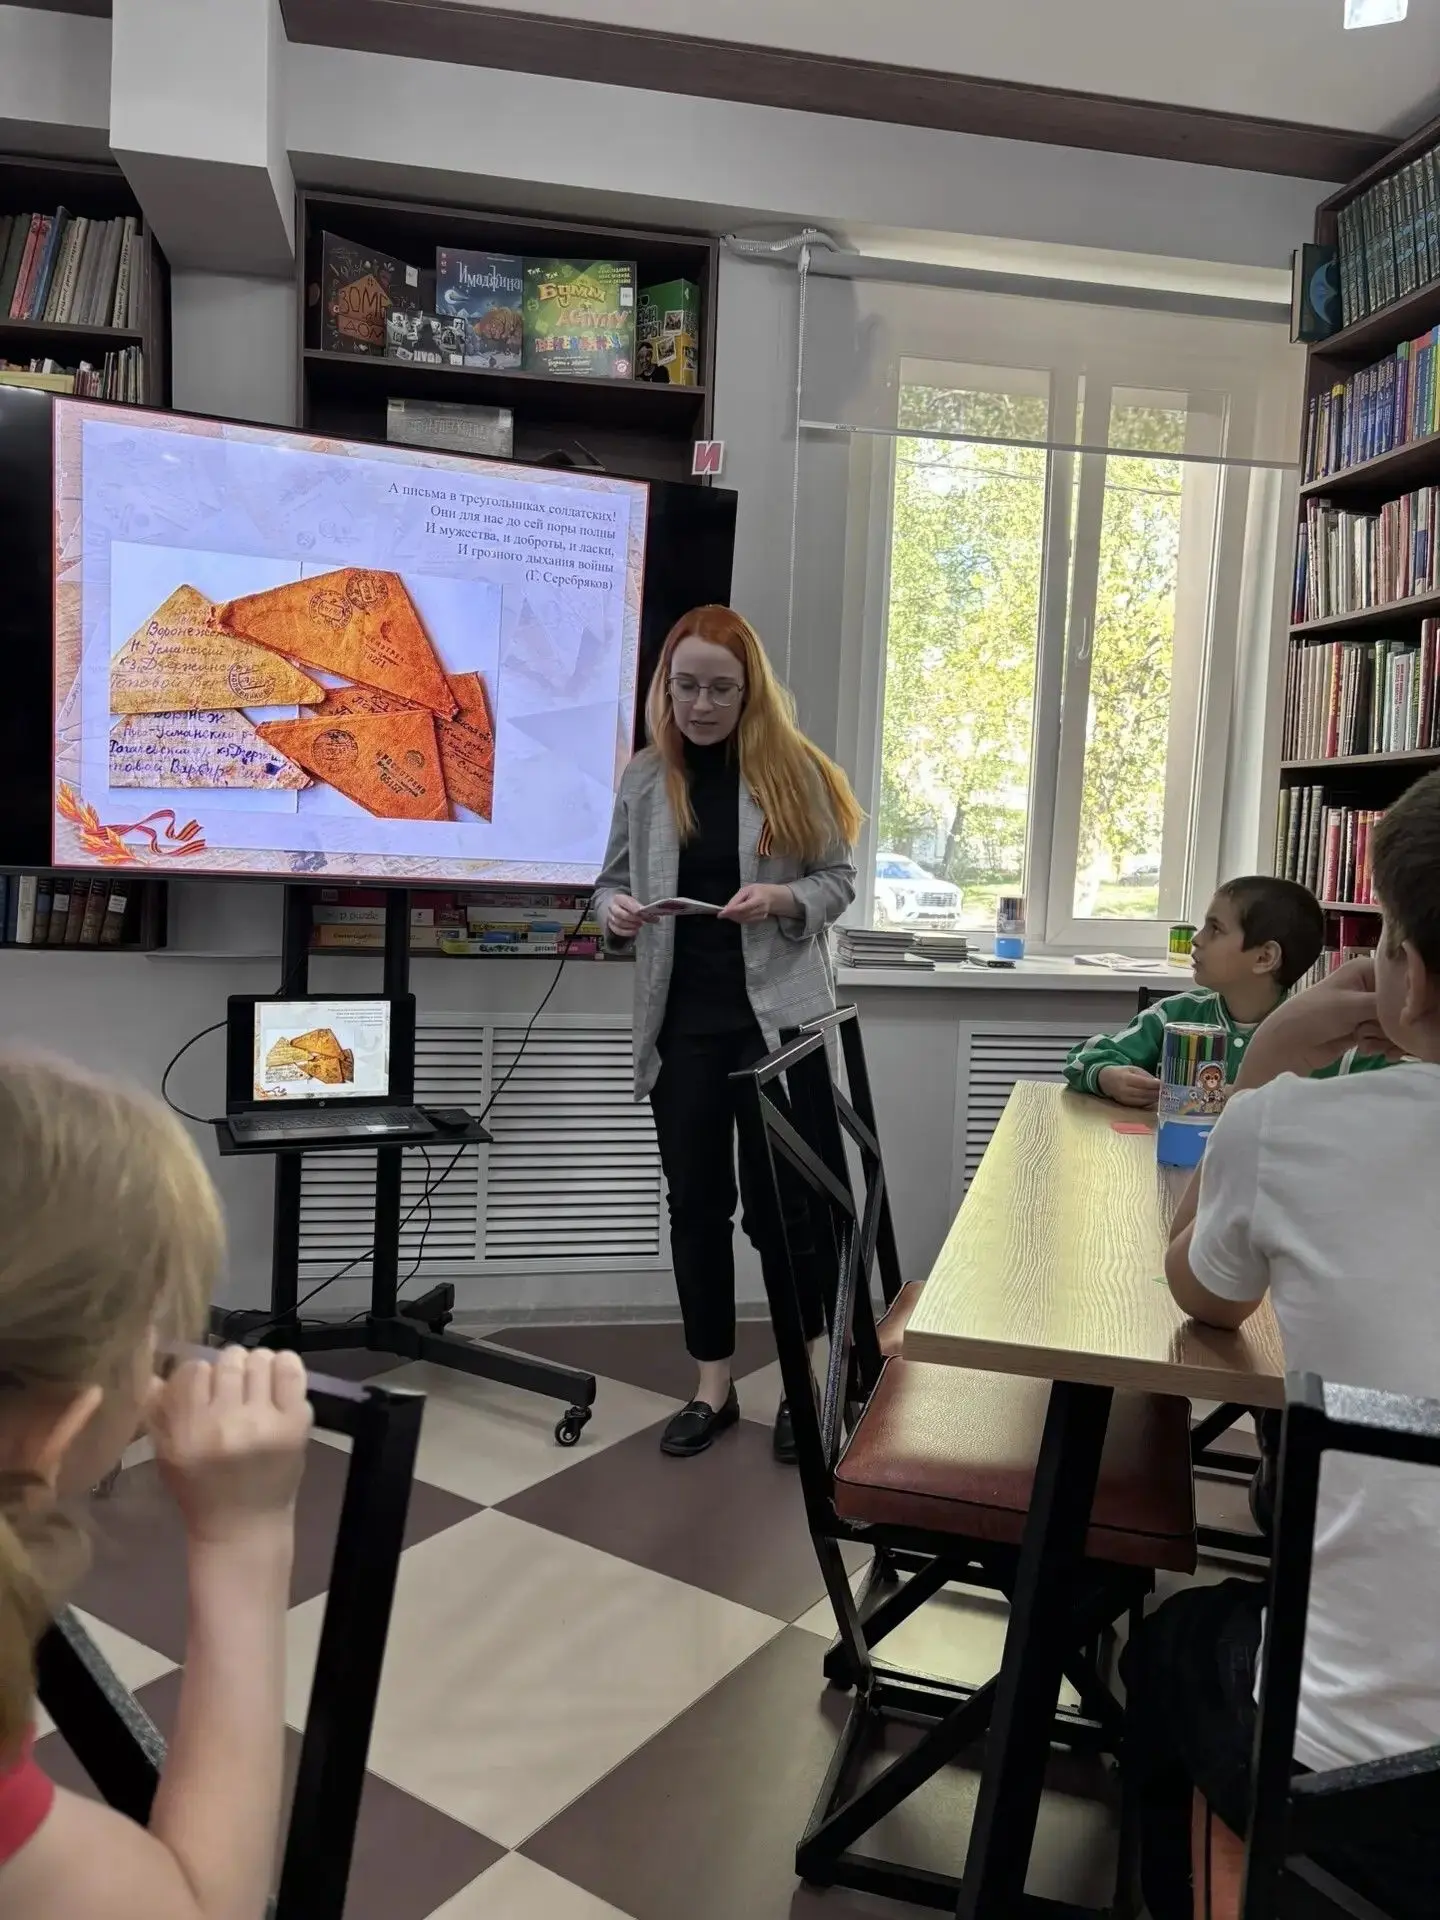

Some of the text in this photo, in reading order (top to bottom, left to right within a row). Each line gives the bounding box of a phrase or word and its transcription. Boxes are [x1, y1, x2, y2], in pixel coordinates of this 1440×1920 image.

[456, 261, 523, 292] Имаджина
[388, 482, 616, 522] А письма в треугольниках солдатских!
[431, 505, 616, 539] Они для нас до сей поры полны
[425, 521, 436, 533] И
[503, 534, 510, 543] и
[513, 535, 566, 550] доброты,
[569, 542, 577, 551] и
[579, 543, 615, 558] ласки,
[458, 543, 614, 573] И грозного дыхания войны
[543, 571, 613, 590] Серебряков)
